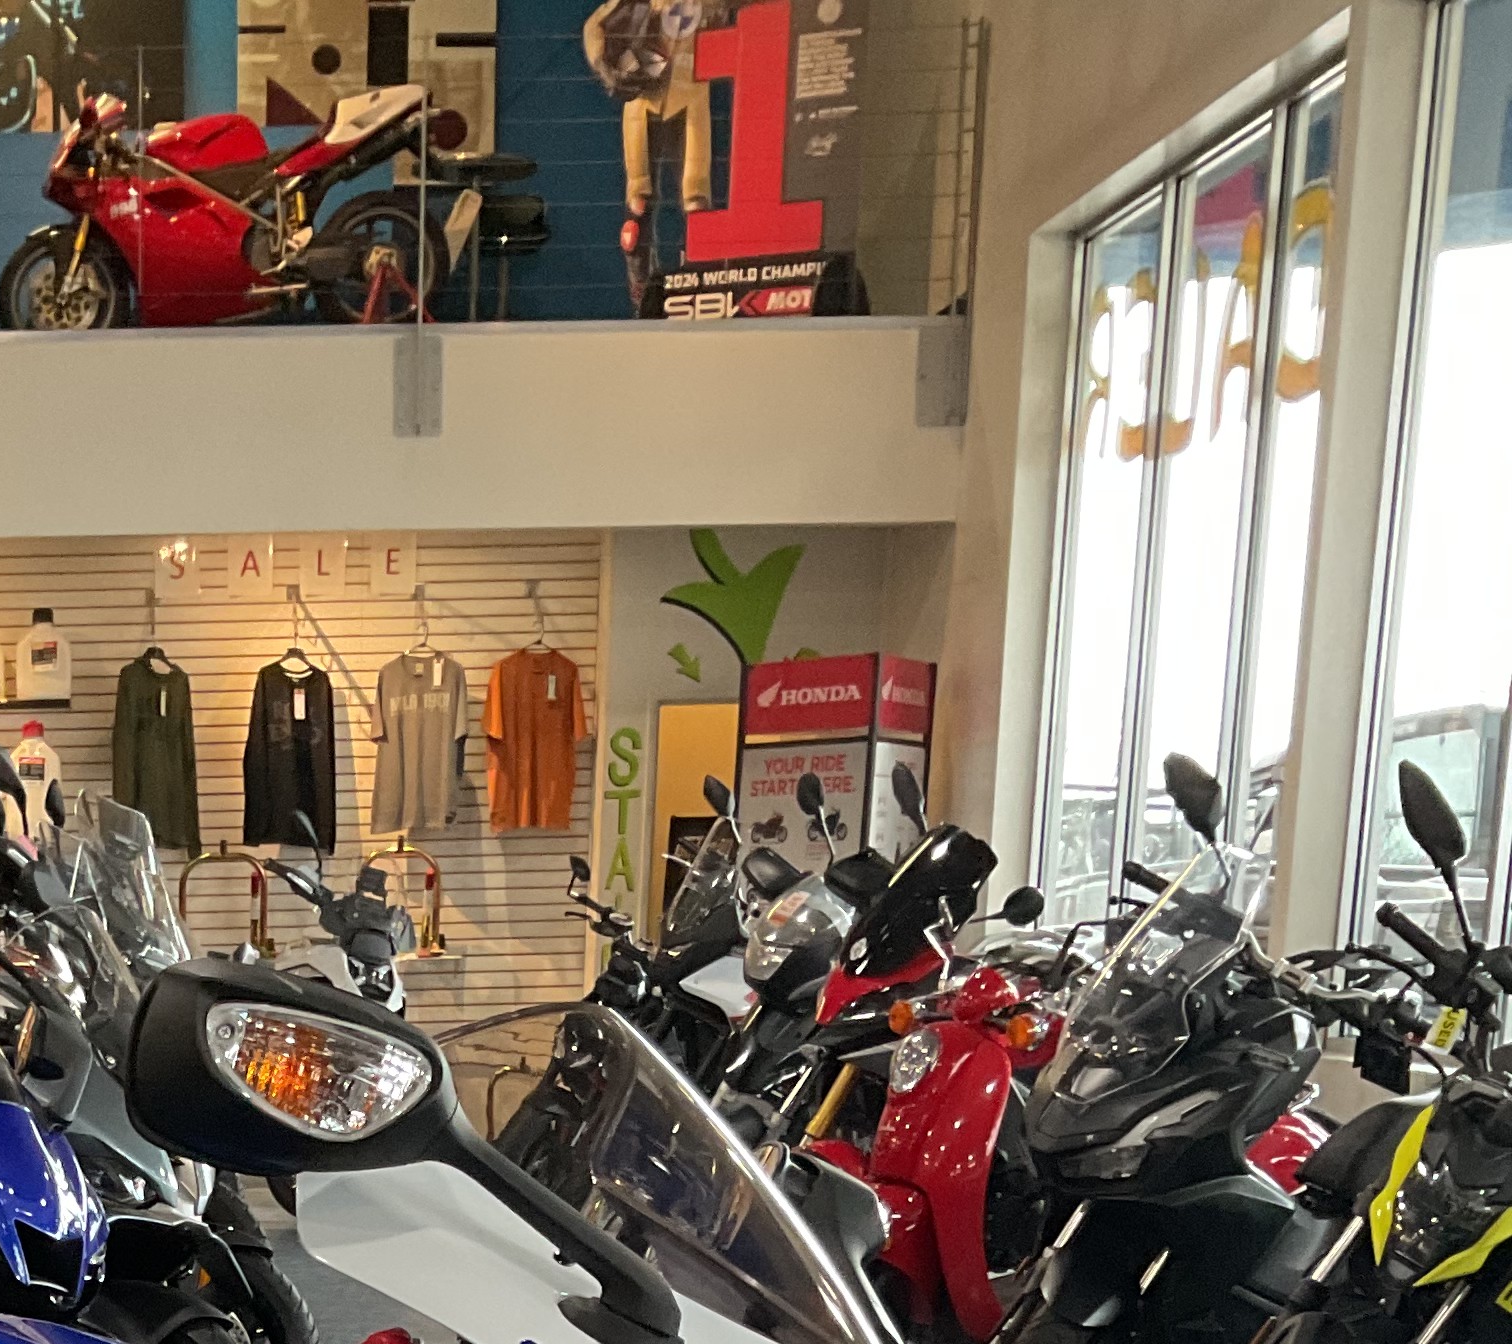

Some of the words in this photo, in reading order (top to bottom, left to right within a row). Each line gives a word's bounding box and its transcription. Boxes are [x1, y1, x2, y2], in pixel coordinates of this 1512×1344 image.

[664, 273, 699, 290] 2024
[703, 267, 757, 286] WORLD
[761, 261, 826, 280] CHAMPI
[780, 683, 864, 708] HONDA
[764, 756, 805, 775] YOUR
[811, 753, 847, 773] RIDE
[823, 775, 857, 794] ERE.
